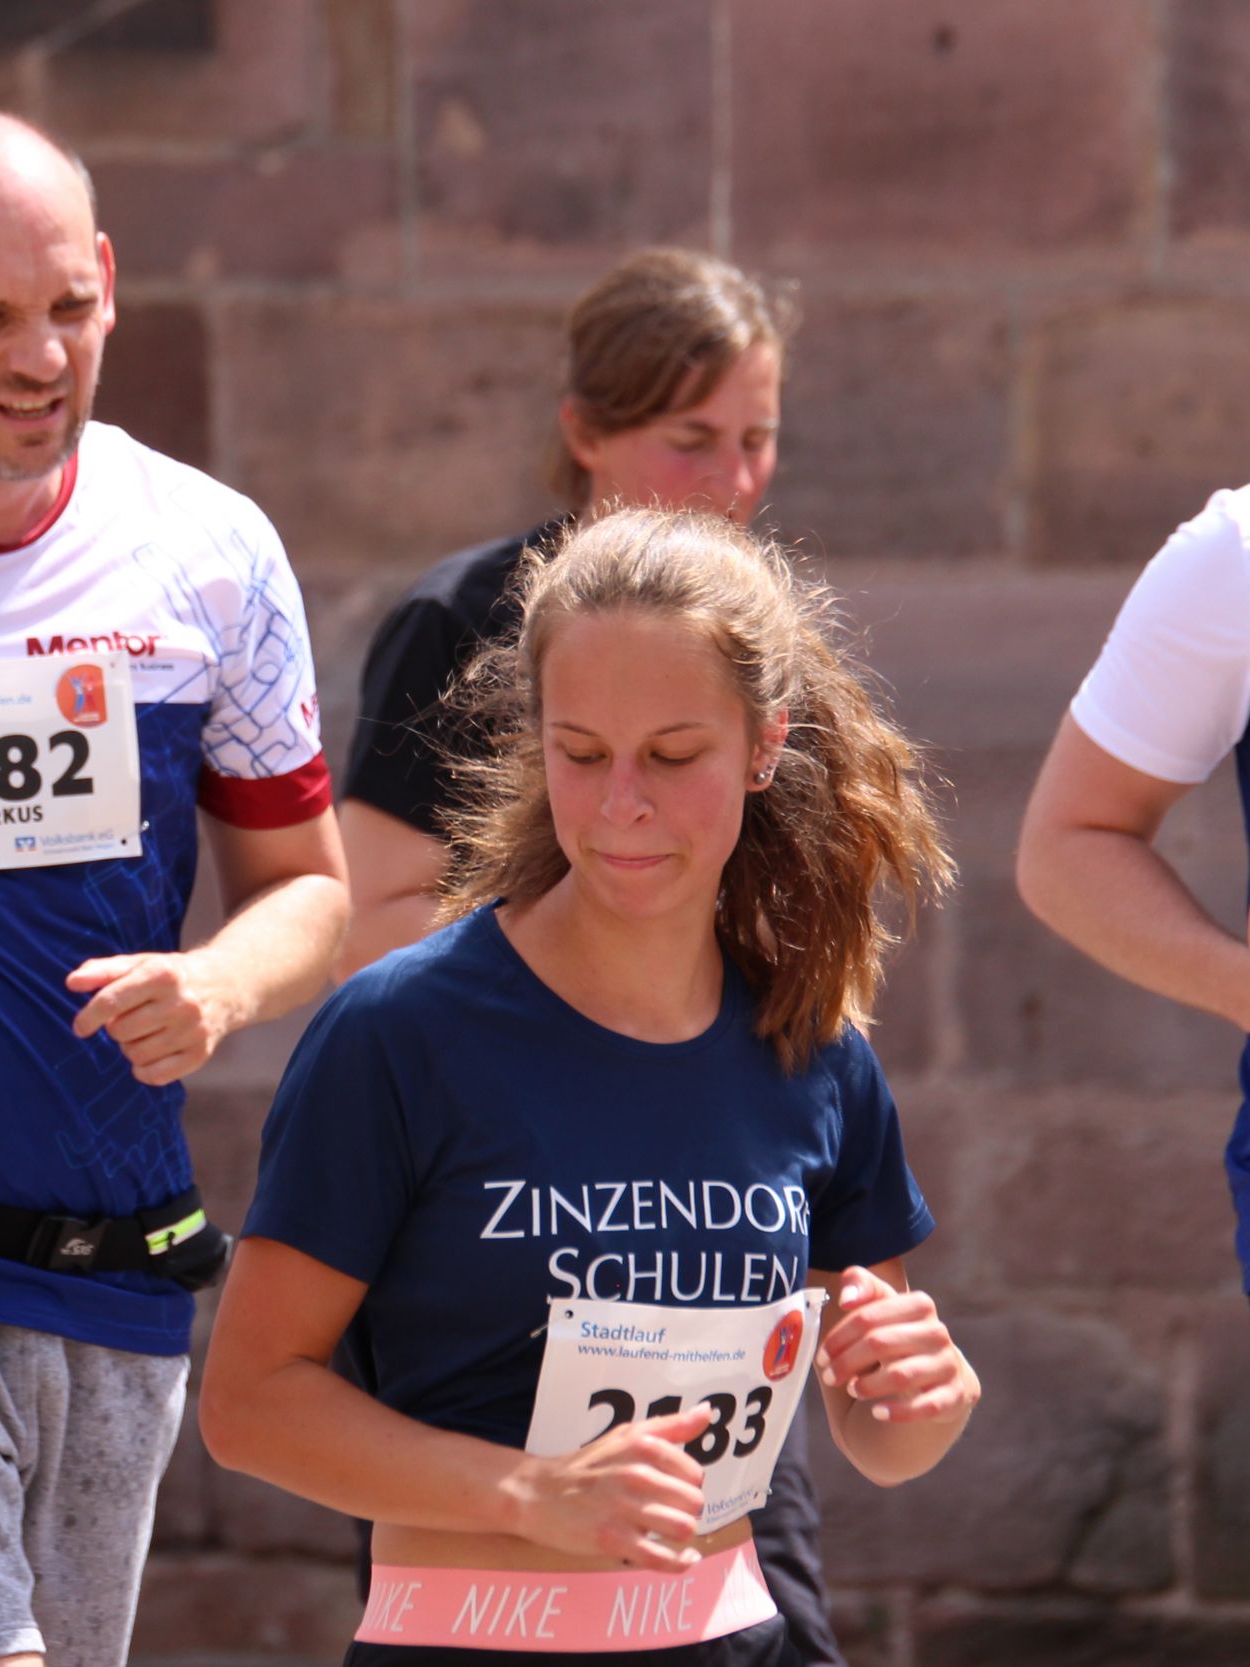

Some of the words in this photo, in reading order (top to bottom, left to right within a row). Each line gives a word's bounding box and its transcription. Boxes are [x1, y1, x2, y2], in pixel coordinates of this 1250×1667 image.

[547, 1247, 799, 1302] SCHULEN
[577, 1342, 747, 1363] www.laufend-mithelfen.de
[580, 1320, 666, 1345] Stadtlauf
[450, 1584, 569, 1639] NIKE
[606, 1576, 696, 1638] NIKE
